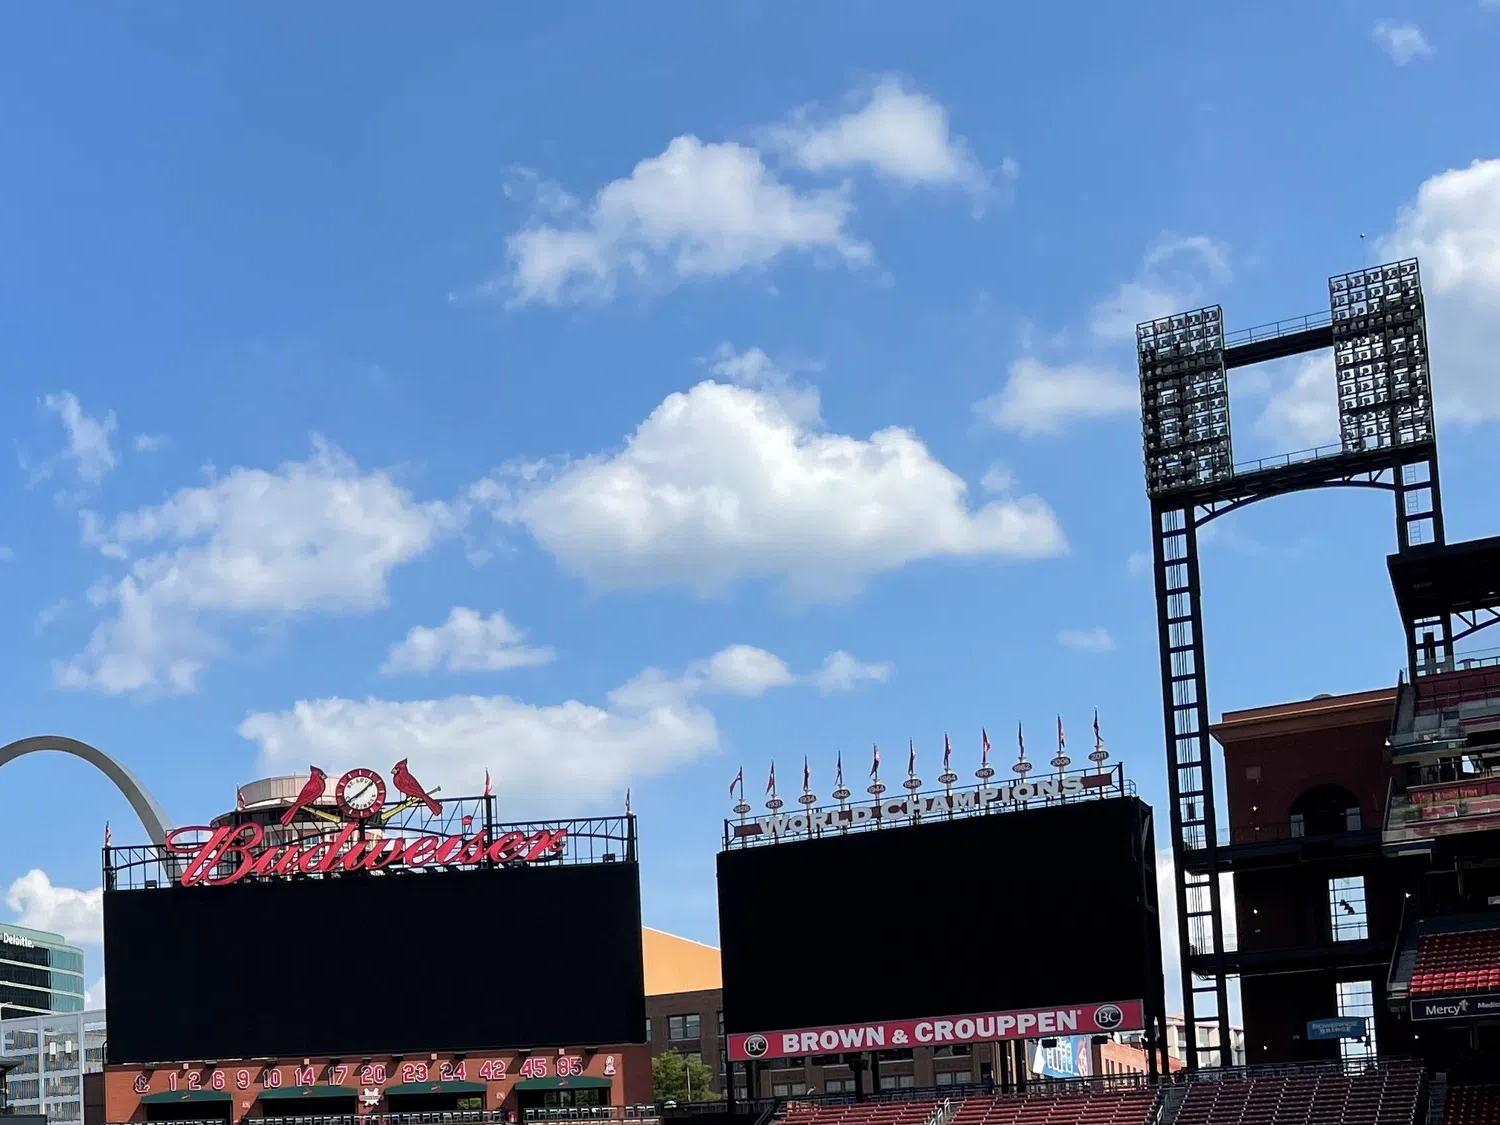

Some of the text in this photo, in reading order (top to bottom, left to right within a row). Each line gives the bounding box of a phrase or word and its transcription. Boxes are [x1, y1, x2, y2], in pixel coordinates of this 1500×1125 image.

[757, 775, 1084, 838] WORLD CHAMPIONS
[165, 821, 567, 887] Budweiser
[1425, 1005, 1460, 1015] Mercy
[782, 1009, 1078, 1054] BROWN & CROUPPEN
[327, 1065, 348, 1085] 17
[361, 1064, 387, 1084] 20
[402, 1063, 428, 1082] 23
[440, 1061, 466, 1081] 24
[479, 1060, 506, 1079] 42
[519, 1058, 546, 1077] 45
[556, 1057, 583, 1076] 85
[169, 1073, 177, 1091] 1
[188, 1072, 201, 1090] 2
[212, 1071, 225, 1089] 6
[236, 1070, 250, 1089] 9
[263, 1069, 282, 1087] 10
[294, 1067, 315, 1086] 14
